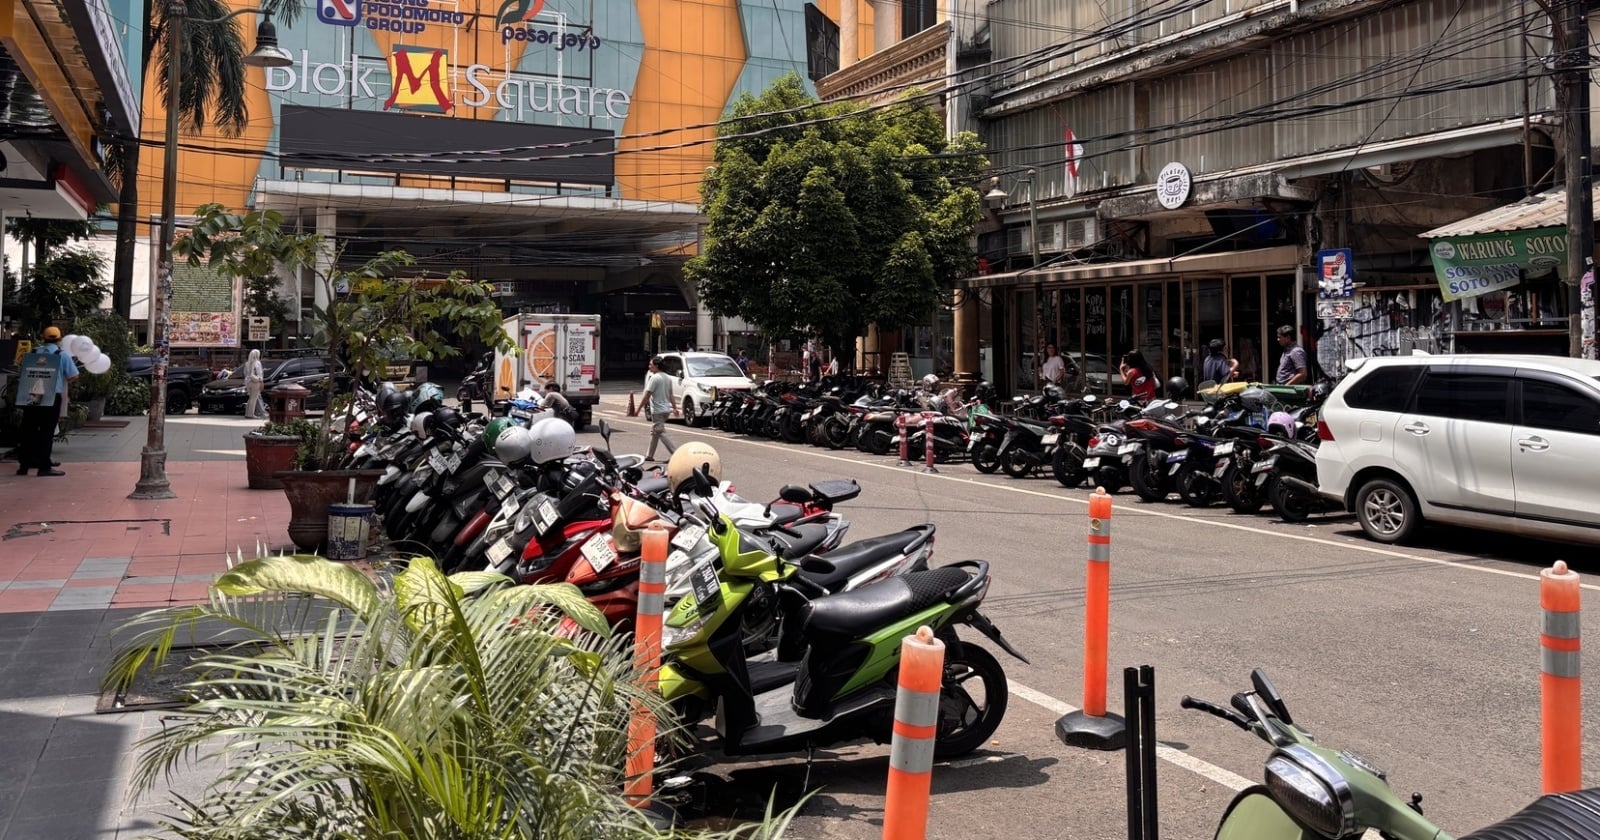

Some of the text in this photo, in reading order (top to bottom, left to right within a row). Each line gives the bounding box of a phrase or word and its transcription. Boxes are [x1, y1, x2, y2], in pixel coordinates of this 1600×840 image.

[367, 4, 464, 24] PODOMORO
[366, 17, 426, 34] GROUP
[265, 47, 631, 122] Blok M Square
[1457, 239, 1516, 261] WARUNG
[1525, 235, 1565, 255] SOTO
[1446, 266, 1481, 279] SOTO
[1449, 277, 1489, 294] SOTO
